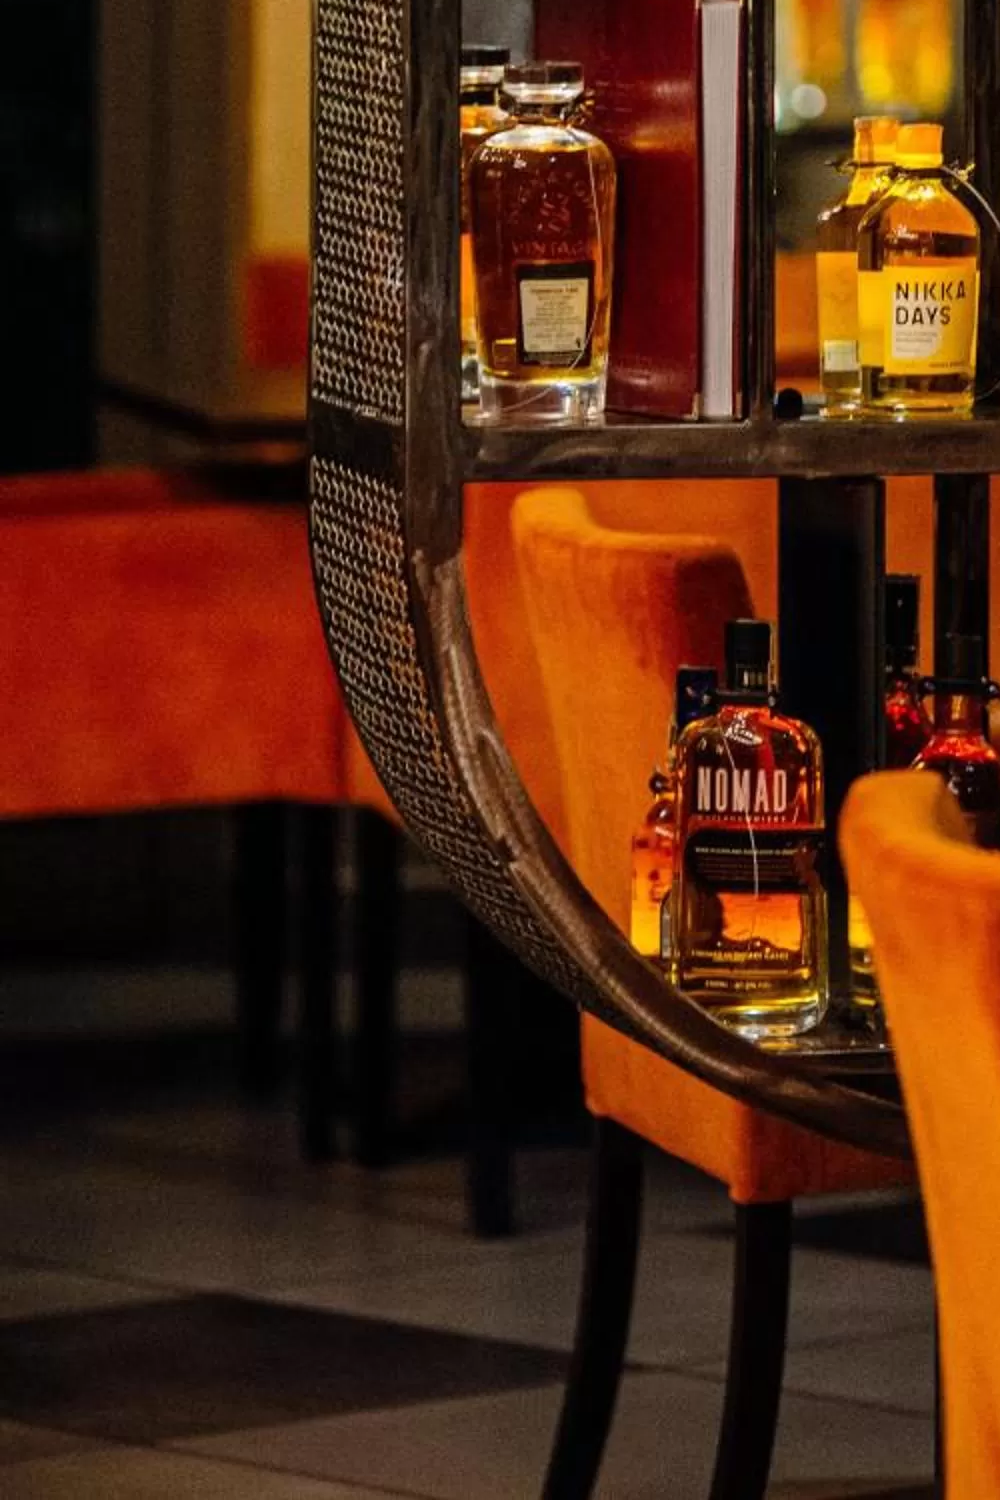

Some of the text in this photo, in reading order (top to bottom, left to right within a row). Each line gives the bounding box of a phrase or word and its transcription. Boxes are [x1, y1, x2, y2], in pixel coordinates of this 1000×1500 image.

[896, 280, 966, 301] NIKKA
[895, 305, 951, 326] DAYS
[697, 766, 787, 813] NOMAD
